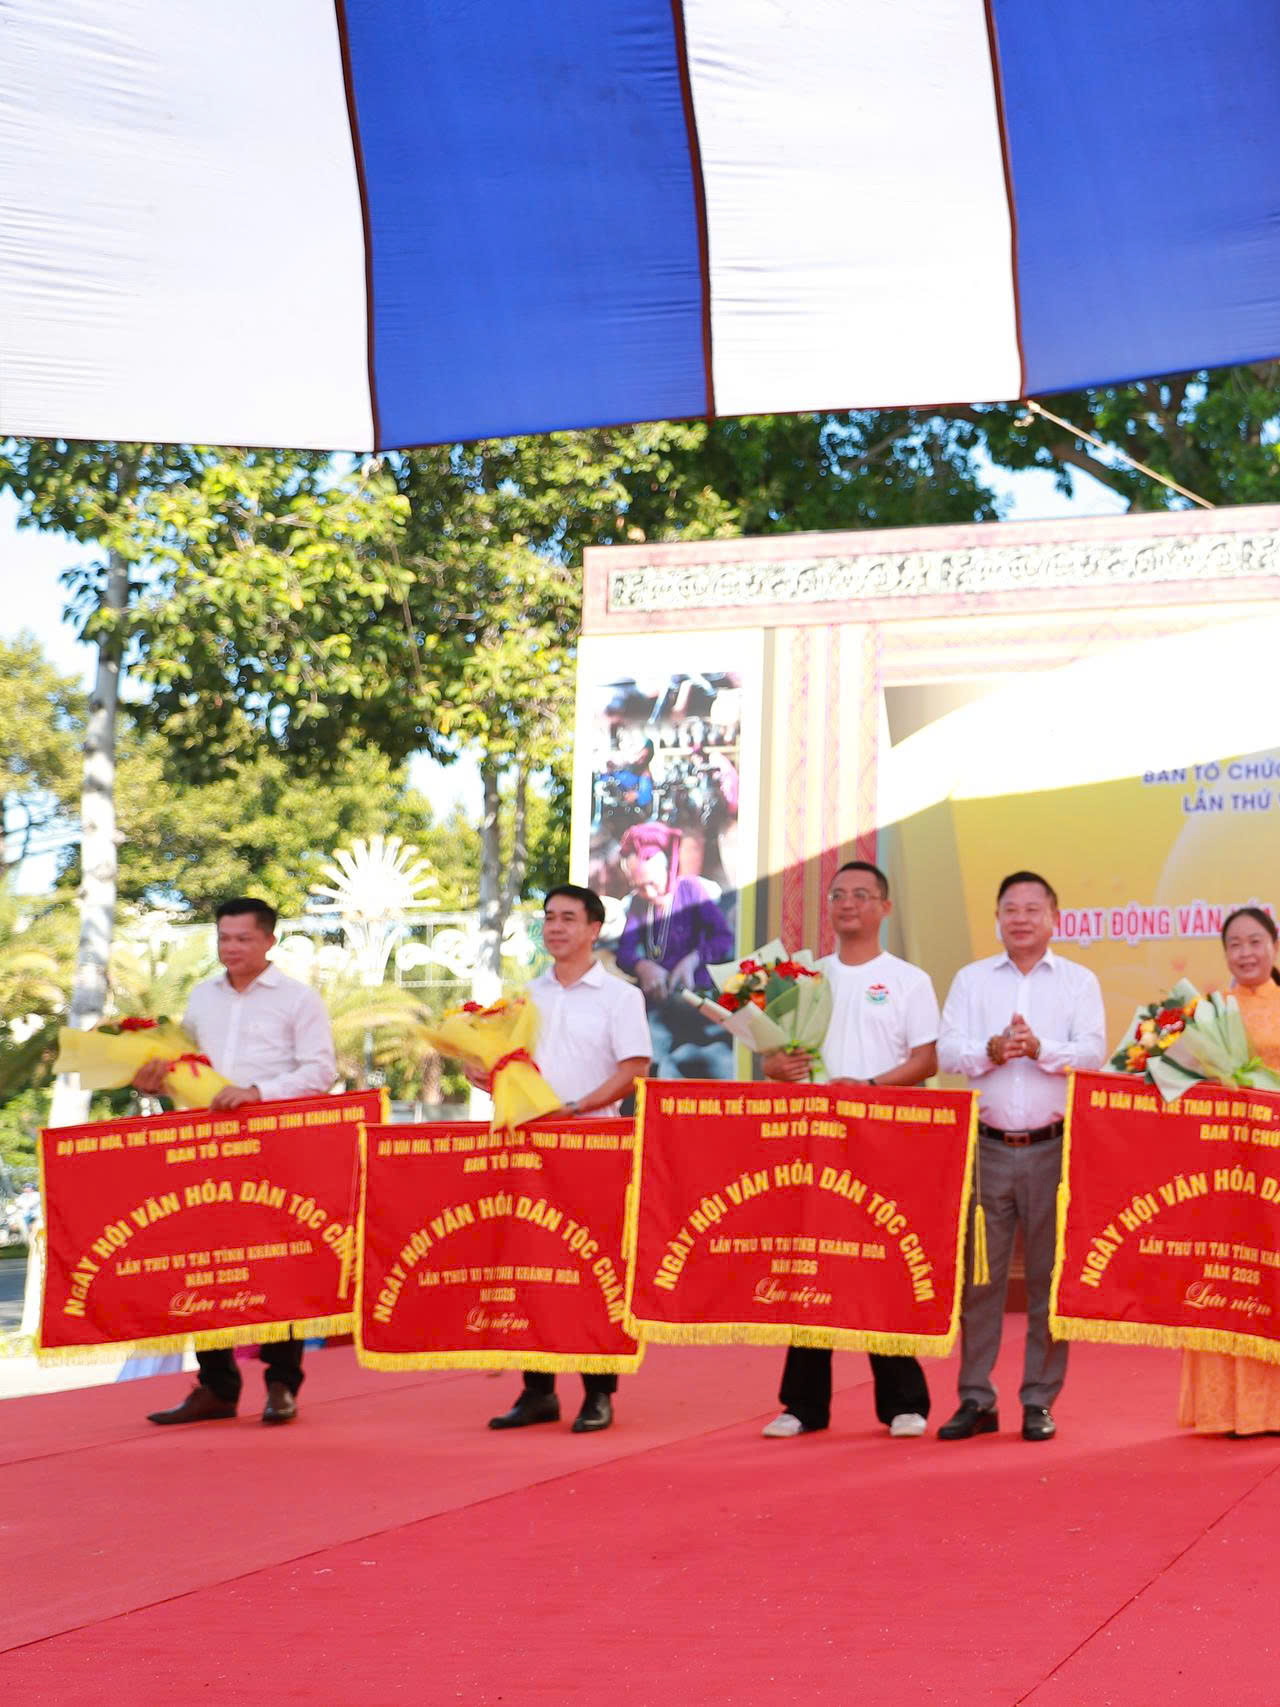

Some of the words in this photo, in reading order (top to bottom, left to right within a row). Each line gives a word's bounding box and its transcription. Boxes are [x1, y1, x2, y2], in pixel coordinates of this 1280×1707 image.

[1184, 786, 1223, 812] LẦN
[1232, 788, 1271, 810] THỨ
[1112, 906, 1170, 942] ĐỘNG
[92, 1219, 133, 1260] HỘI
[130, 1190, 181, 1228] VĂN
[185, 1178, 233, 1208] HÓA
[240, 1180, 287, 1209] DÂN
[288, 1193, 327, 1230] TỘC
[400, 1230, 433, 1267] HỘI
[430, 1202, 475, 1239] VĂN
[515, 1196, 563, 1232] DÂN
[562, 1220, 599, 1260] TỘC
[654, 1227, 696, 1291] NGÀY
[689, 1194, 728, 1232] HỘI
[725, 1171, 769, 1206] VĂN
[774, 1159, 814, 1187] HÓA
[819, 1167, 867, 1205] DÂN
[867, 1193, 907, 1235] TỘC
[899, 1233, 936, 1303] CHĂM
[1080, 1227, 1125, 1287] NGÀY
[1119, 1196, 1159, 1231] HỘI
[1159, 1172, 1208, 1206] VĂN
[1214, 1165, 1256, 1193] HÓA
